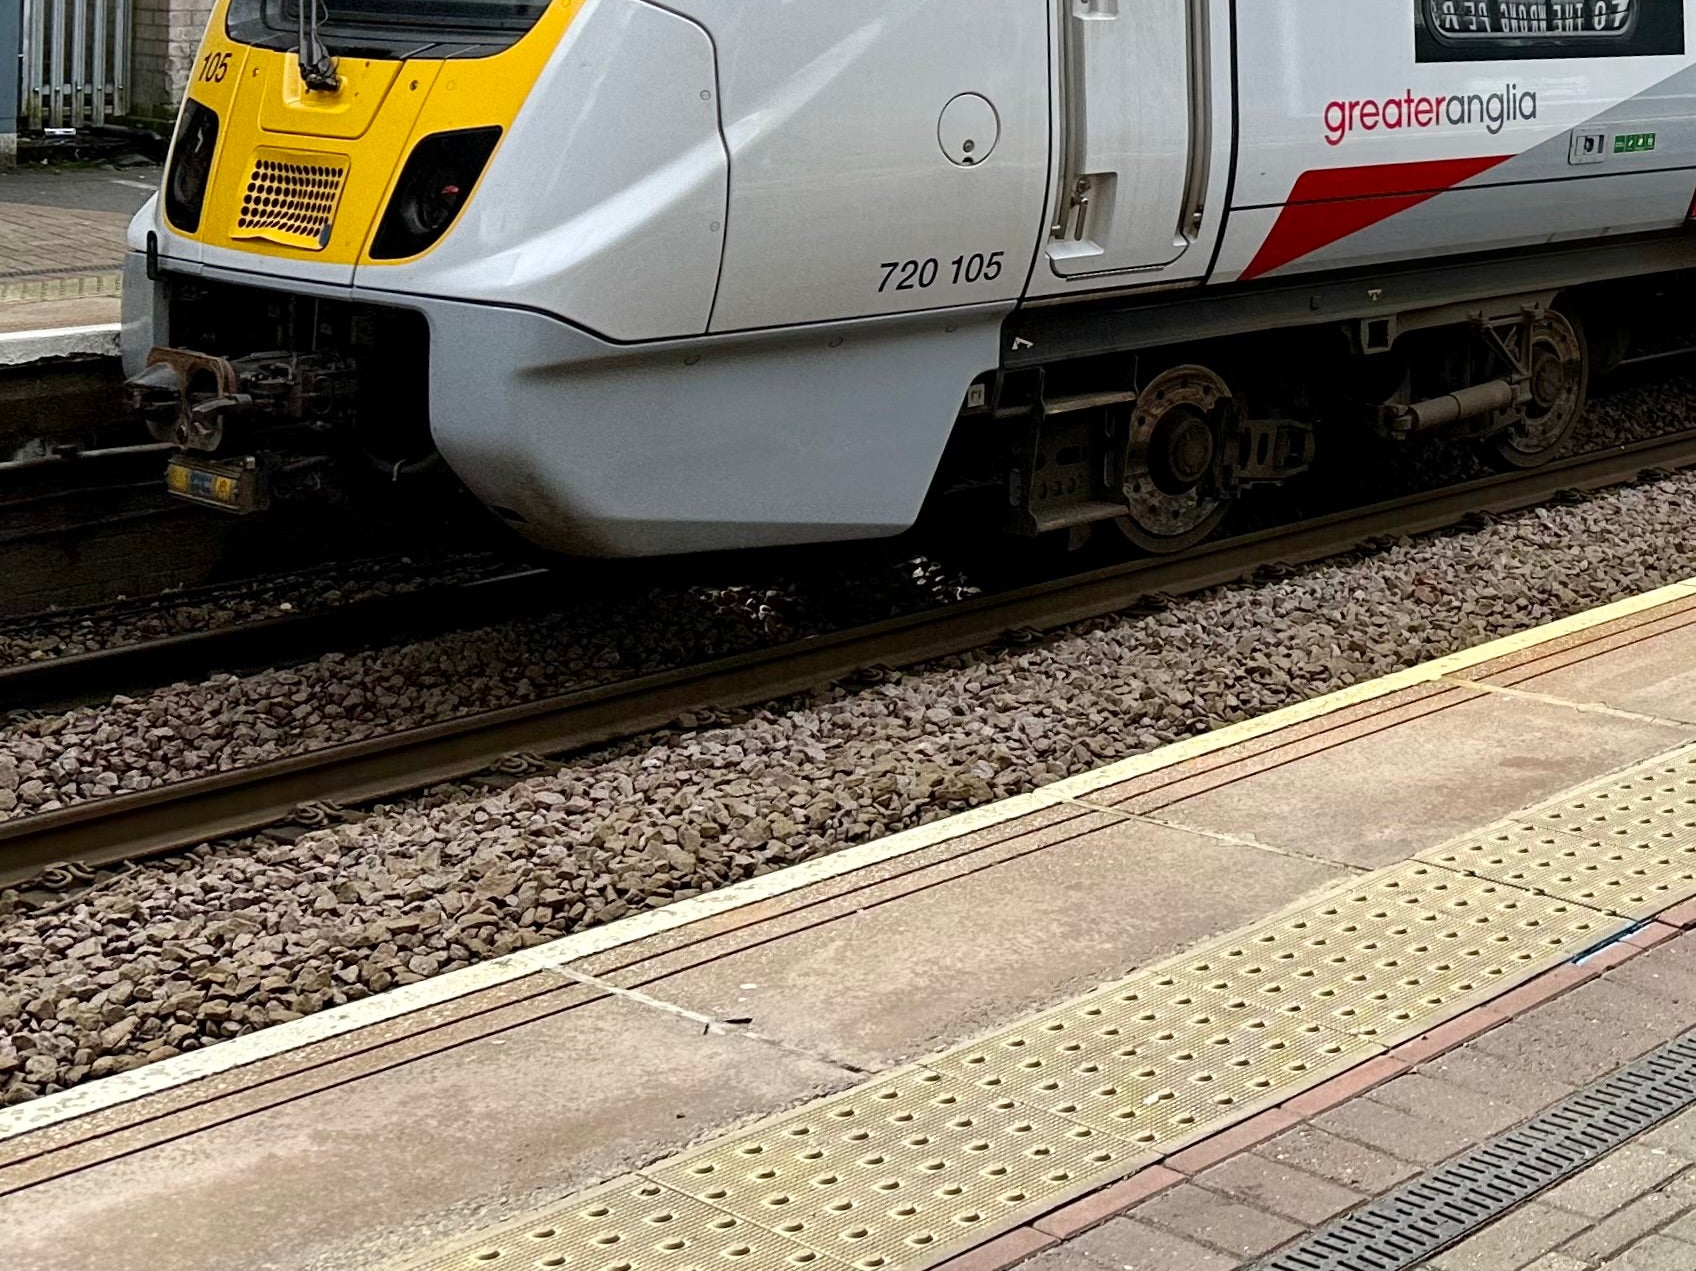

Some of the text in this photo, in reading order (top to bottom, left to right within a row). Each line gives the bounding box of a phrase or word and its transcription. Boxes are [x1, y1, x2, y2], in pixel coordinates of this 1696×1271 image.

[198, 51, 233, 83] 105
[1324, 83, 1537, 146] greateranglia
[878, 251, 1005, 293] 720 105
